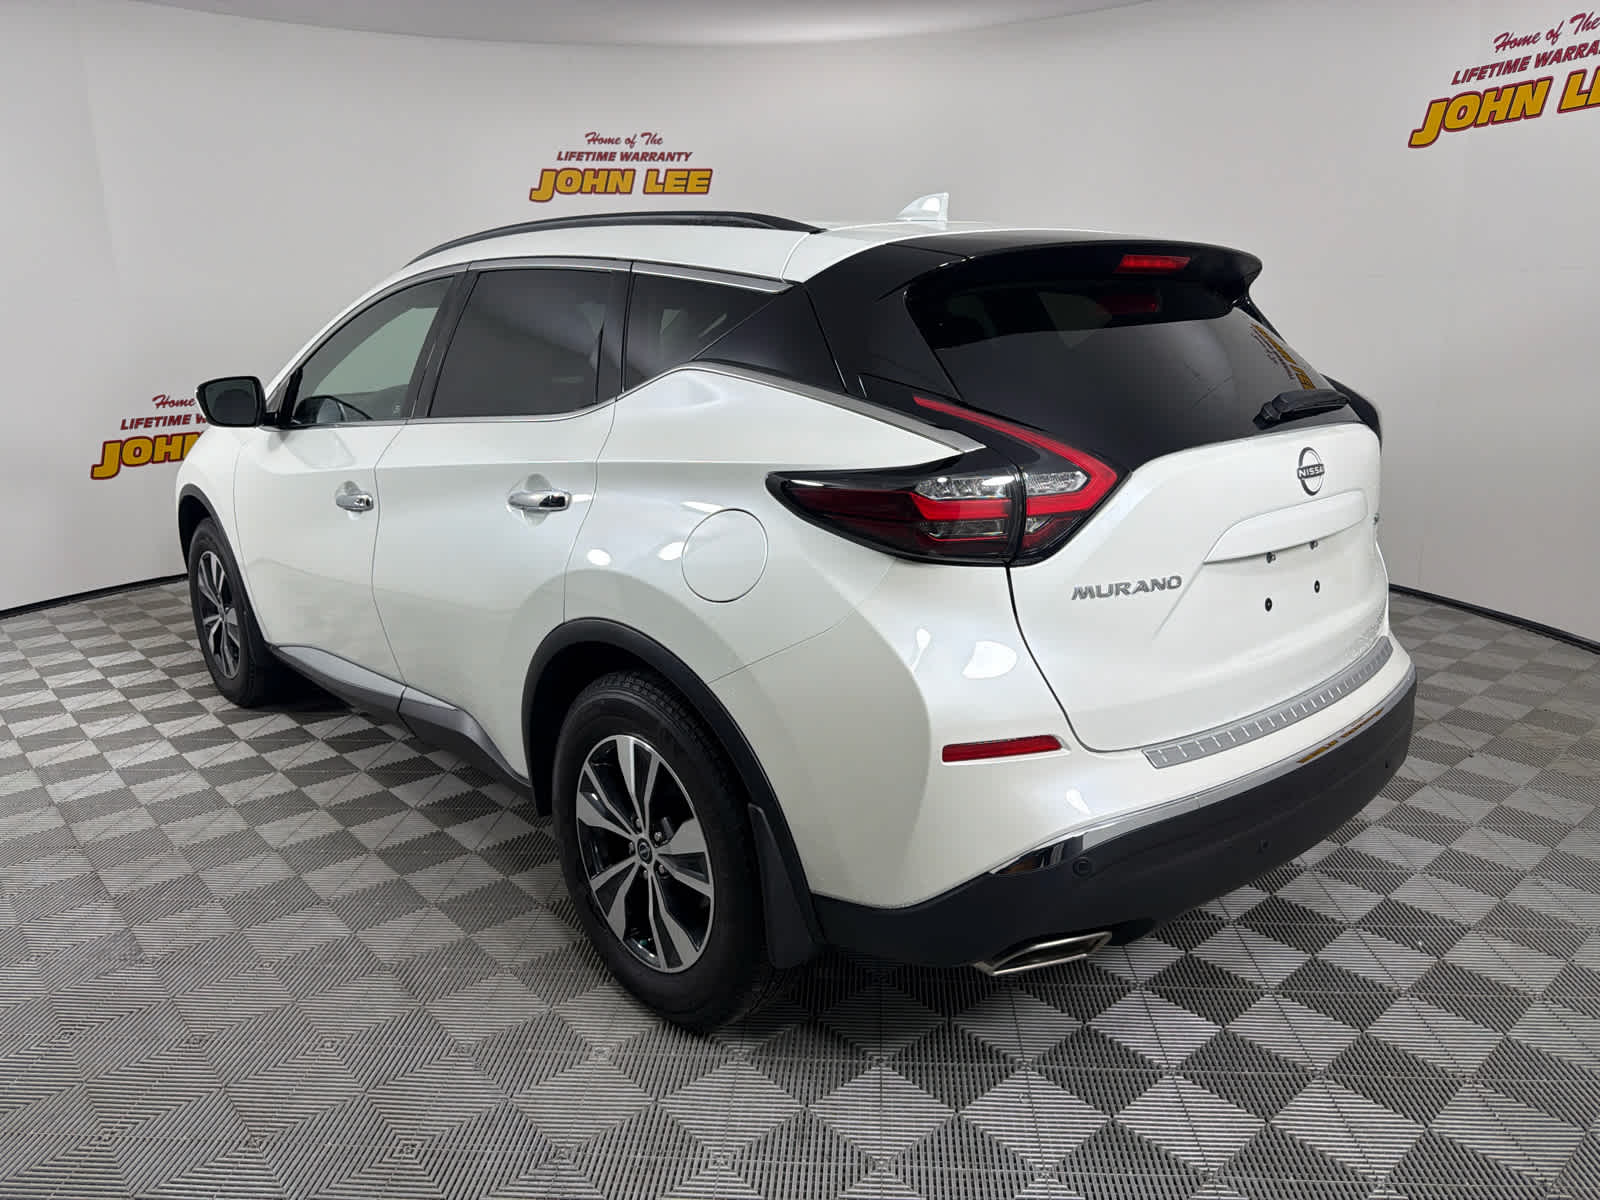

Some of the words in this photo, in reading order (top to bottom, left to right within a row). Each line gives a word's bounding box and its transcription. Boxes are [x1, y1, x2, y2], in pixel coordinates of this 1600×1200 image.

[1493, 31, 1541, 54] Home
[1545, 20, 1564, 46] of
[1569, 11, 1600, 36] The
[1451, 55, 1532, 85] LIFETIME
[1534, 39, 1600, 69] WARRA
[1408, 75, 1554, 148] JOHN
[584, 131, 621, 146] Home
[624, 133, 637, 148] of
[640, 132, 664, 146] The
[556, 151, 616, 162] LIFETIME
[619, 151, 693, 162] WARRANTY
[529, 168, 636, 203] JOHN
[643, 168, 713, 195] LEE
[151, 394, 196, 409] Home
[120, 414, 192, 431] LIFETIME
[1071, 575, 1182, 601] MURANO
